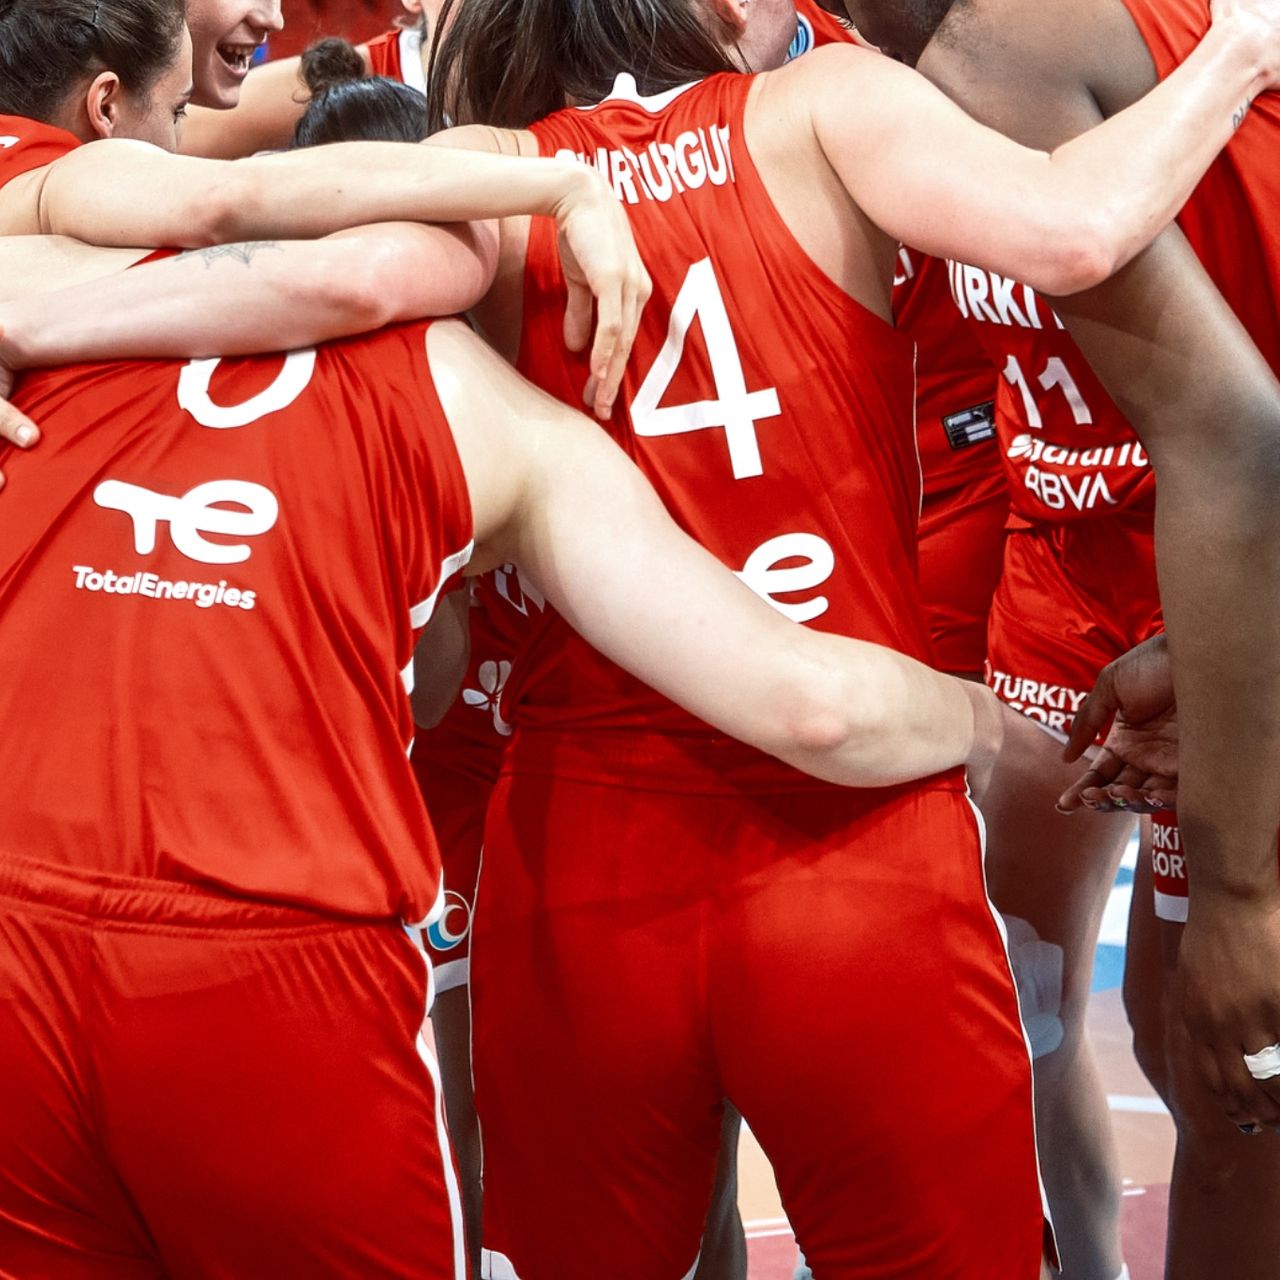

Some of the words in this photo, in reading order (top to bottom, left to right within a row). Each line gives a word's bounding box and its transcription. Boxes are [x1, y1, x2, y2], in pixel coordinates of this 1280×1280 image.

[630, 256, 782, 480] 4
[1002, 354, 1093, 429] 11
[72, 565, 257, 610] TotalEnergies
